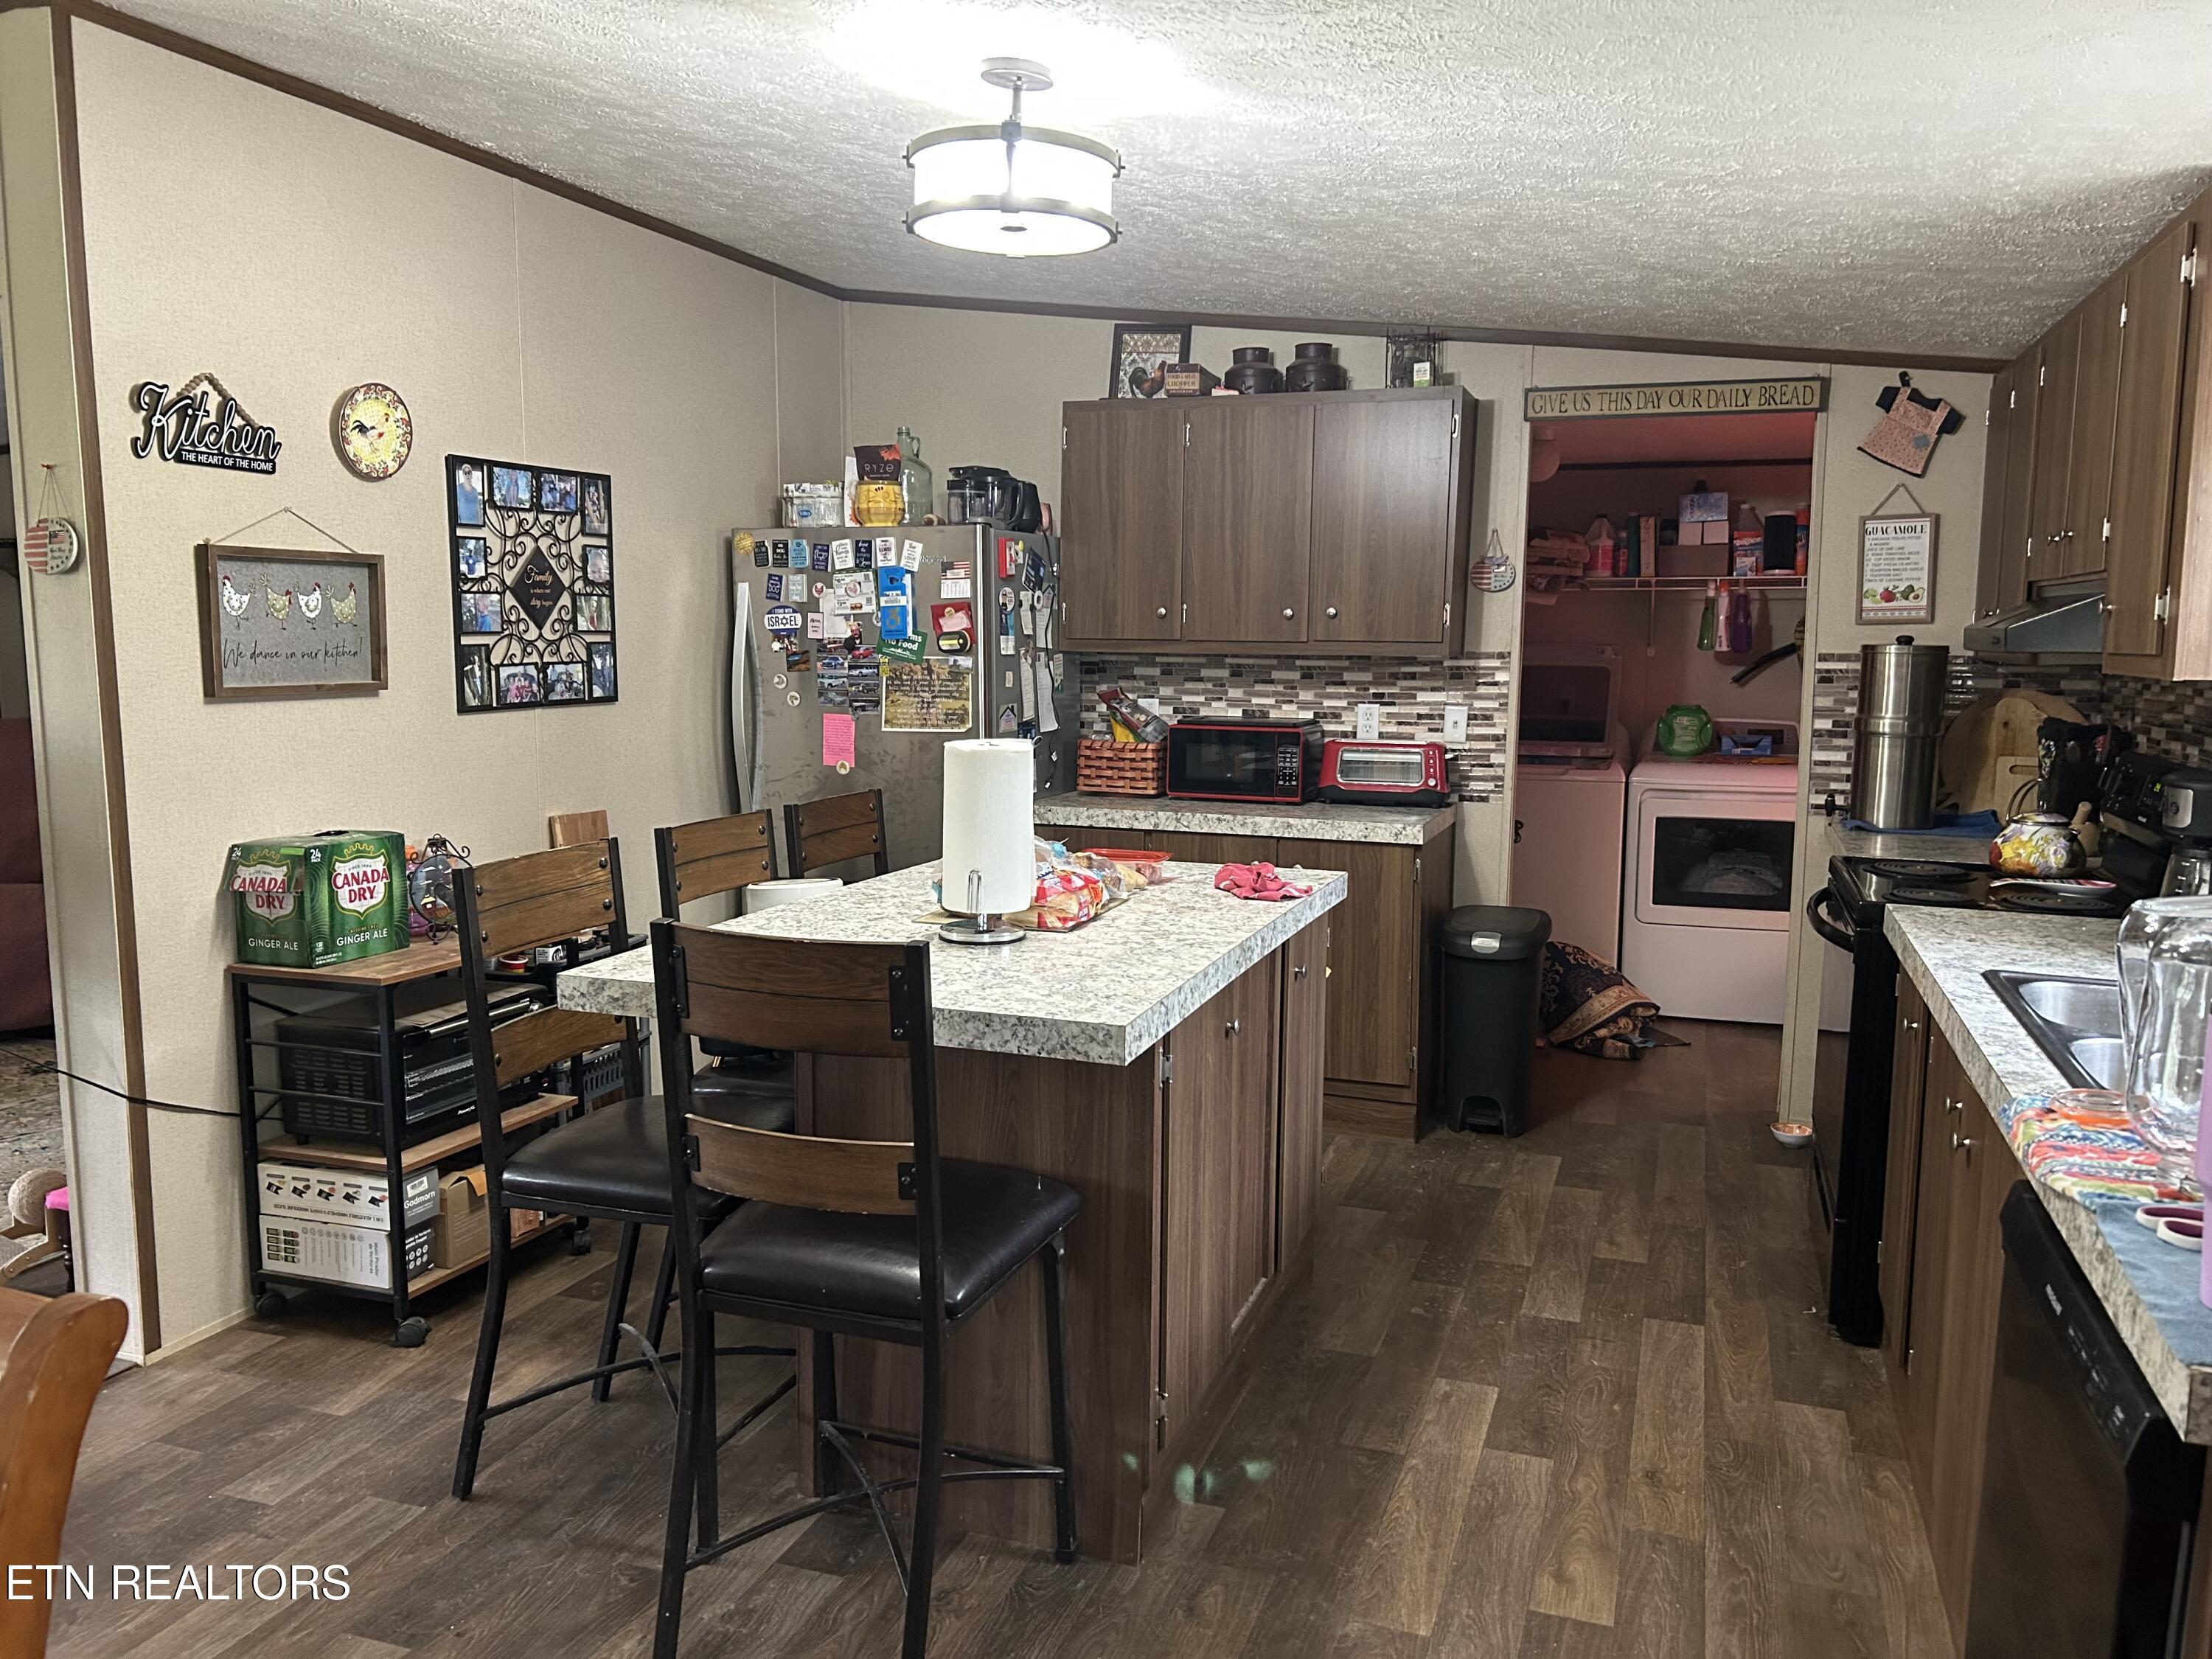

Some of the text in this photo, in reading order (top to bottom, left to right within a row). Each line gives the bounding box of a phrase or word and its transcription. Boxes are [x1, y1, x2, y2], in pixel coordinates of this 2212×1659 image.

[1531, 384, 1815, 414] GIVE US THIS DAY OUR DAILY BREAD
[137, 384, 280, 459] Kitchen
[181, 451, 274, 472] THE HEART OF THE HOME
[1865, 524, 1927, 536] GUACAMOLE
[524, 565, 553, 586] Family
[768, 585, 780, 594] DOG
[223, 637, 363, 669] We dance in our kitchen!
[898, 640, 919, 650] Food
[232, 847, 242, 857] 24
[310, 848, 321, 859] 24
[230, 874, 287, 893] CANADA
[332, 867, 390, 890] CANADA
[255, 894, 285, 910] DRY
[348, 886, 377, 903] DRY
[248, 937, 299, 951] GINGER ALE
[336, 928, 389, 947] GINGER ALE
[457, 1105, 476, 1116] PowerXL
[403, 1190, 436, 1209] Godmorn
